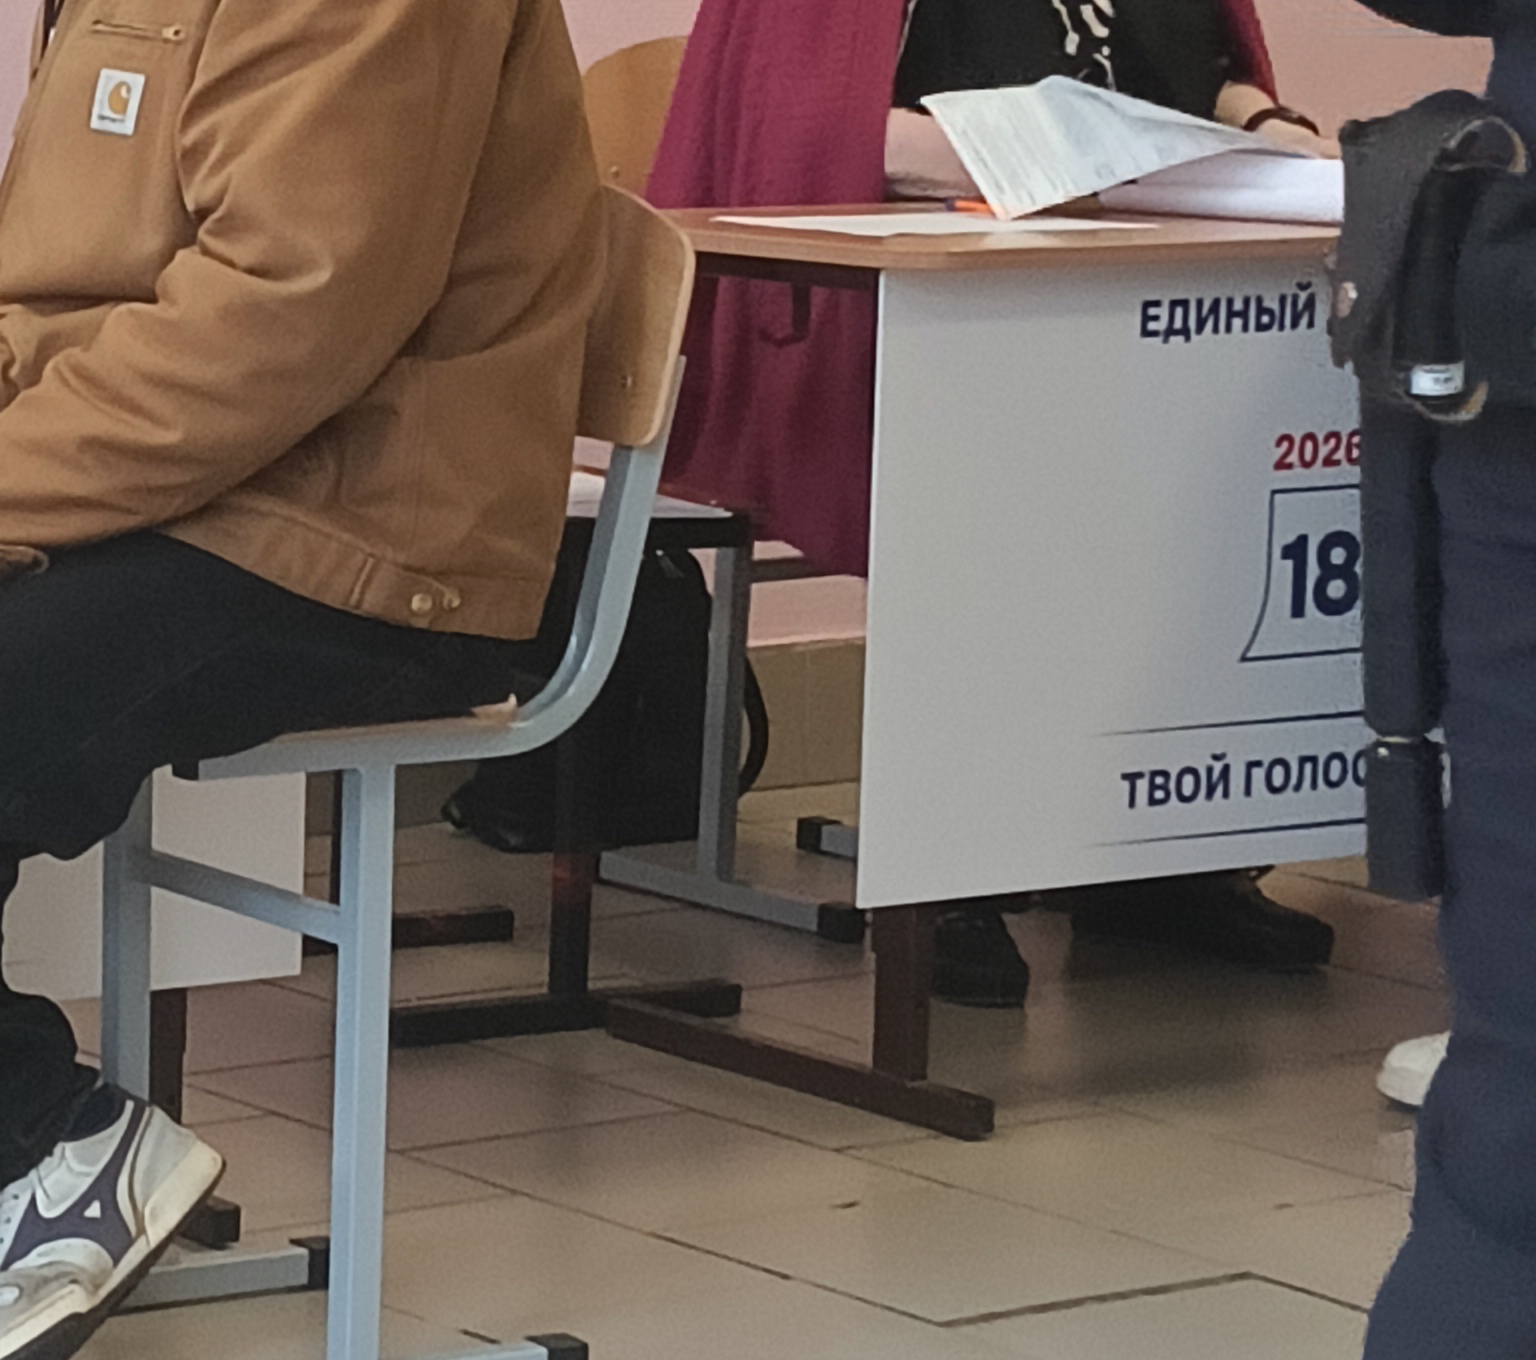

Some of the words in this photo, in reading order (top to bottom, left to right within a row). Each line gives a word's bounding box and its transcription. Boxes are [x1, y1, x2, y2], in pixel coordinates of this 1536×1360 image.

[1140, 281, 1317, 343] ЕДИНЫЙ
[1273, 428, 1361, 471] 2026
[1280, 530, 1361, 619] 18
[1121, 752, 1231, 810] ТВОЙ
